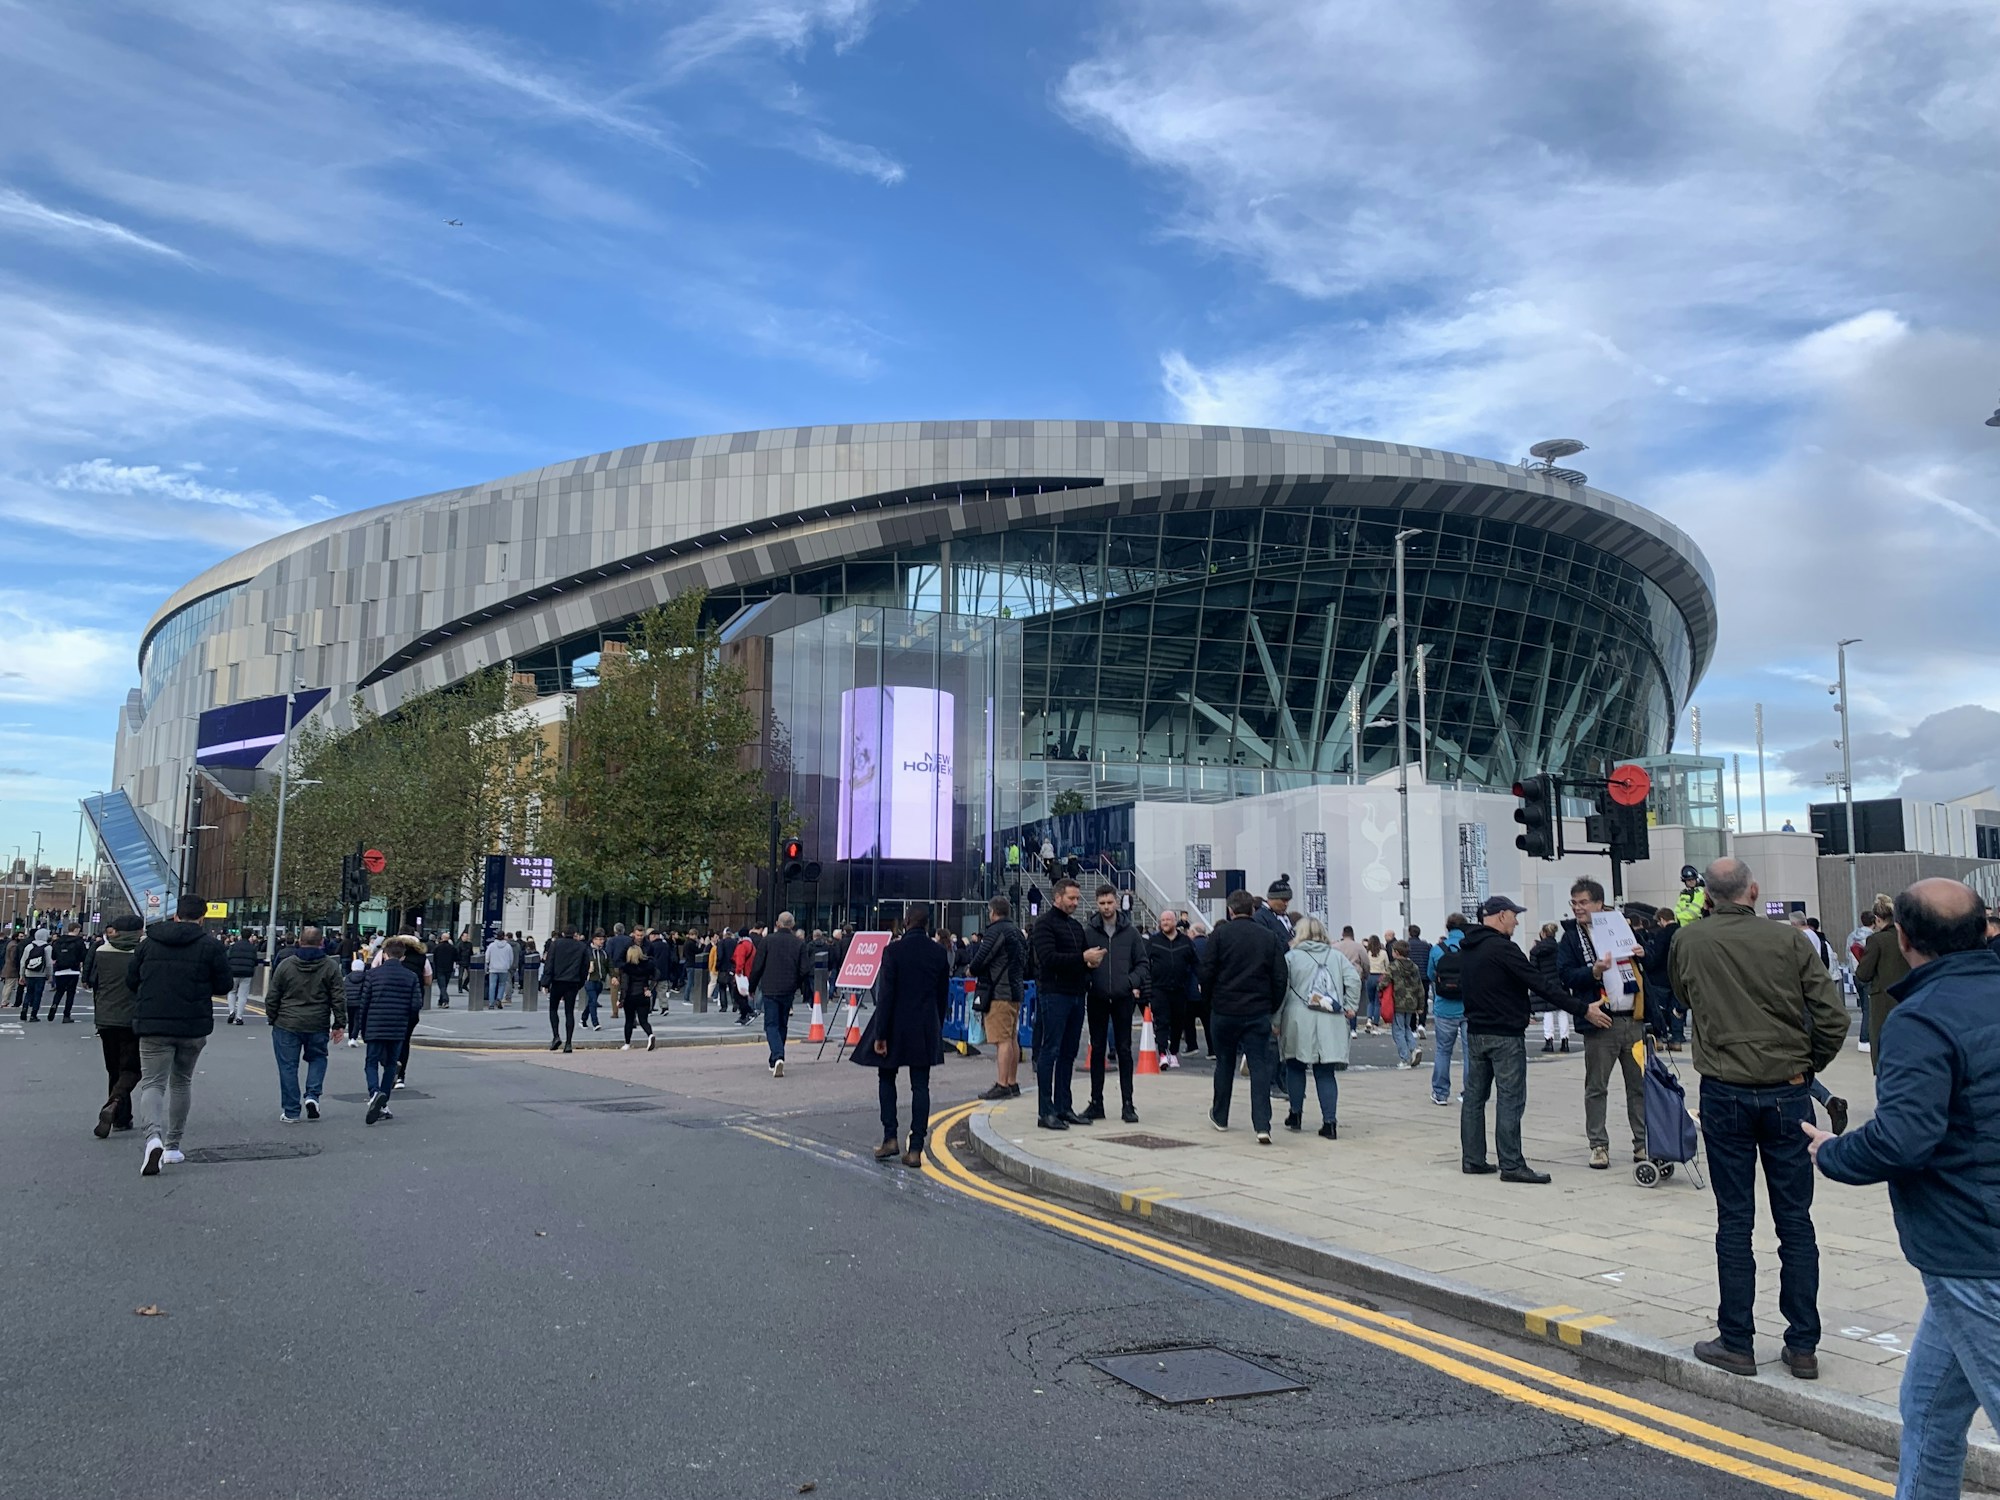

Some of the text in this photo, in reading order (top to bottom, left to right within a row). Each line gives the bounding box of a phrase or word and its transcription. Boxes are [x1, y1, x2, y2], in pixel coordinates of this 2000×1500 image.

[925, 752, 950, 764] NEW
[903, 761, 946, 775] HOME
[520, 868, 541, 876] 11-21
[531, 879, 541, 887] 22
[1608, 928, 1615, 936] IS
[1616, 938, 1634, 947] LORD
[855, 942, 878, 955] ROAD
[844, 963, 874, 976] CLOSED
